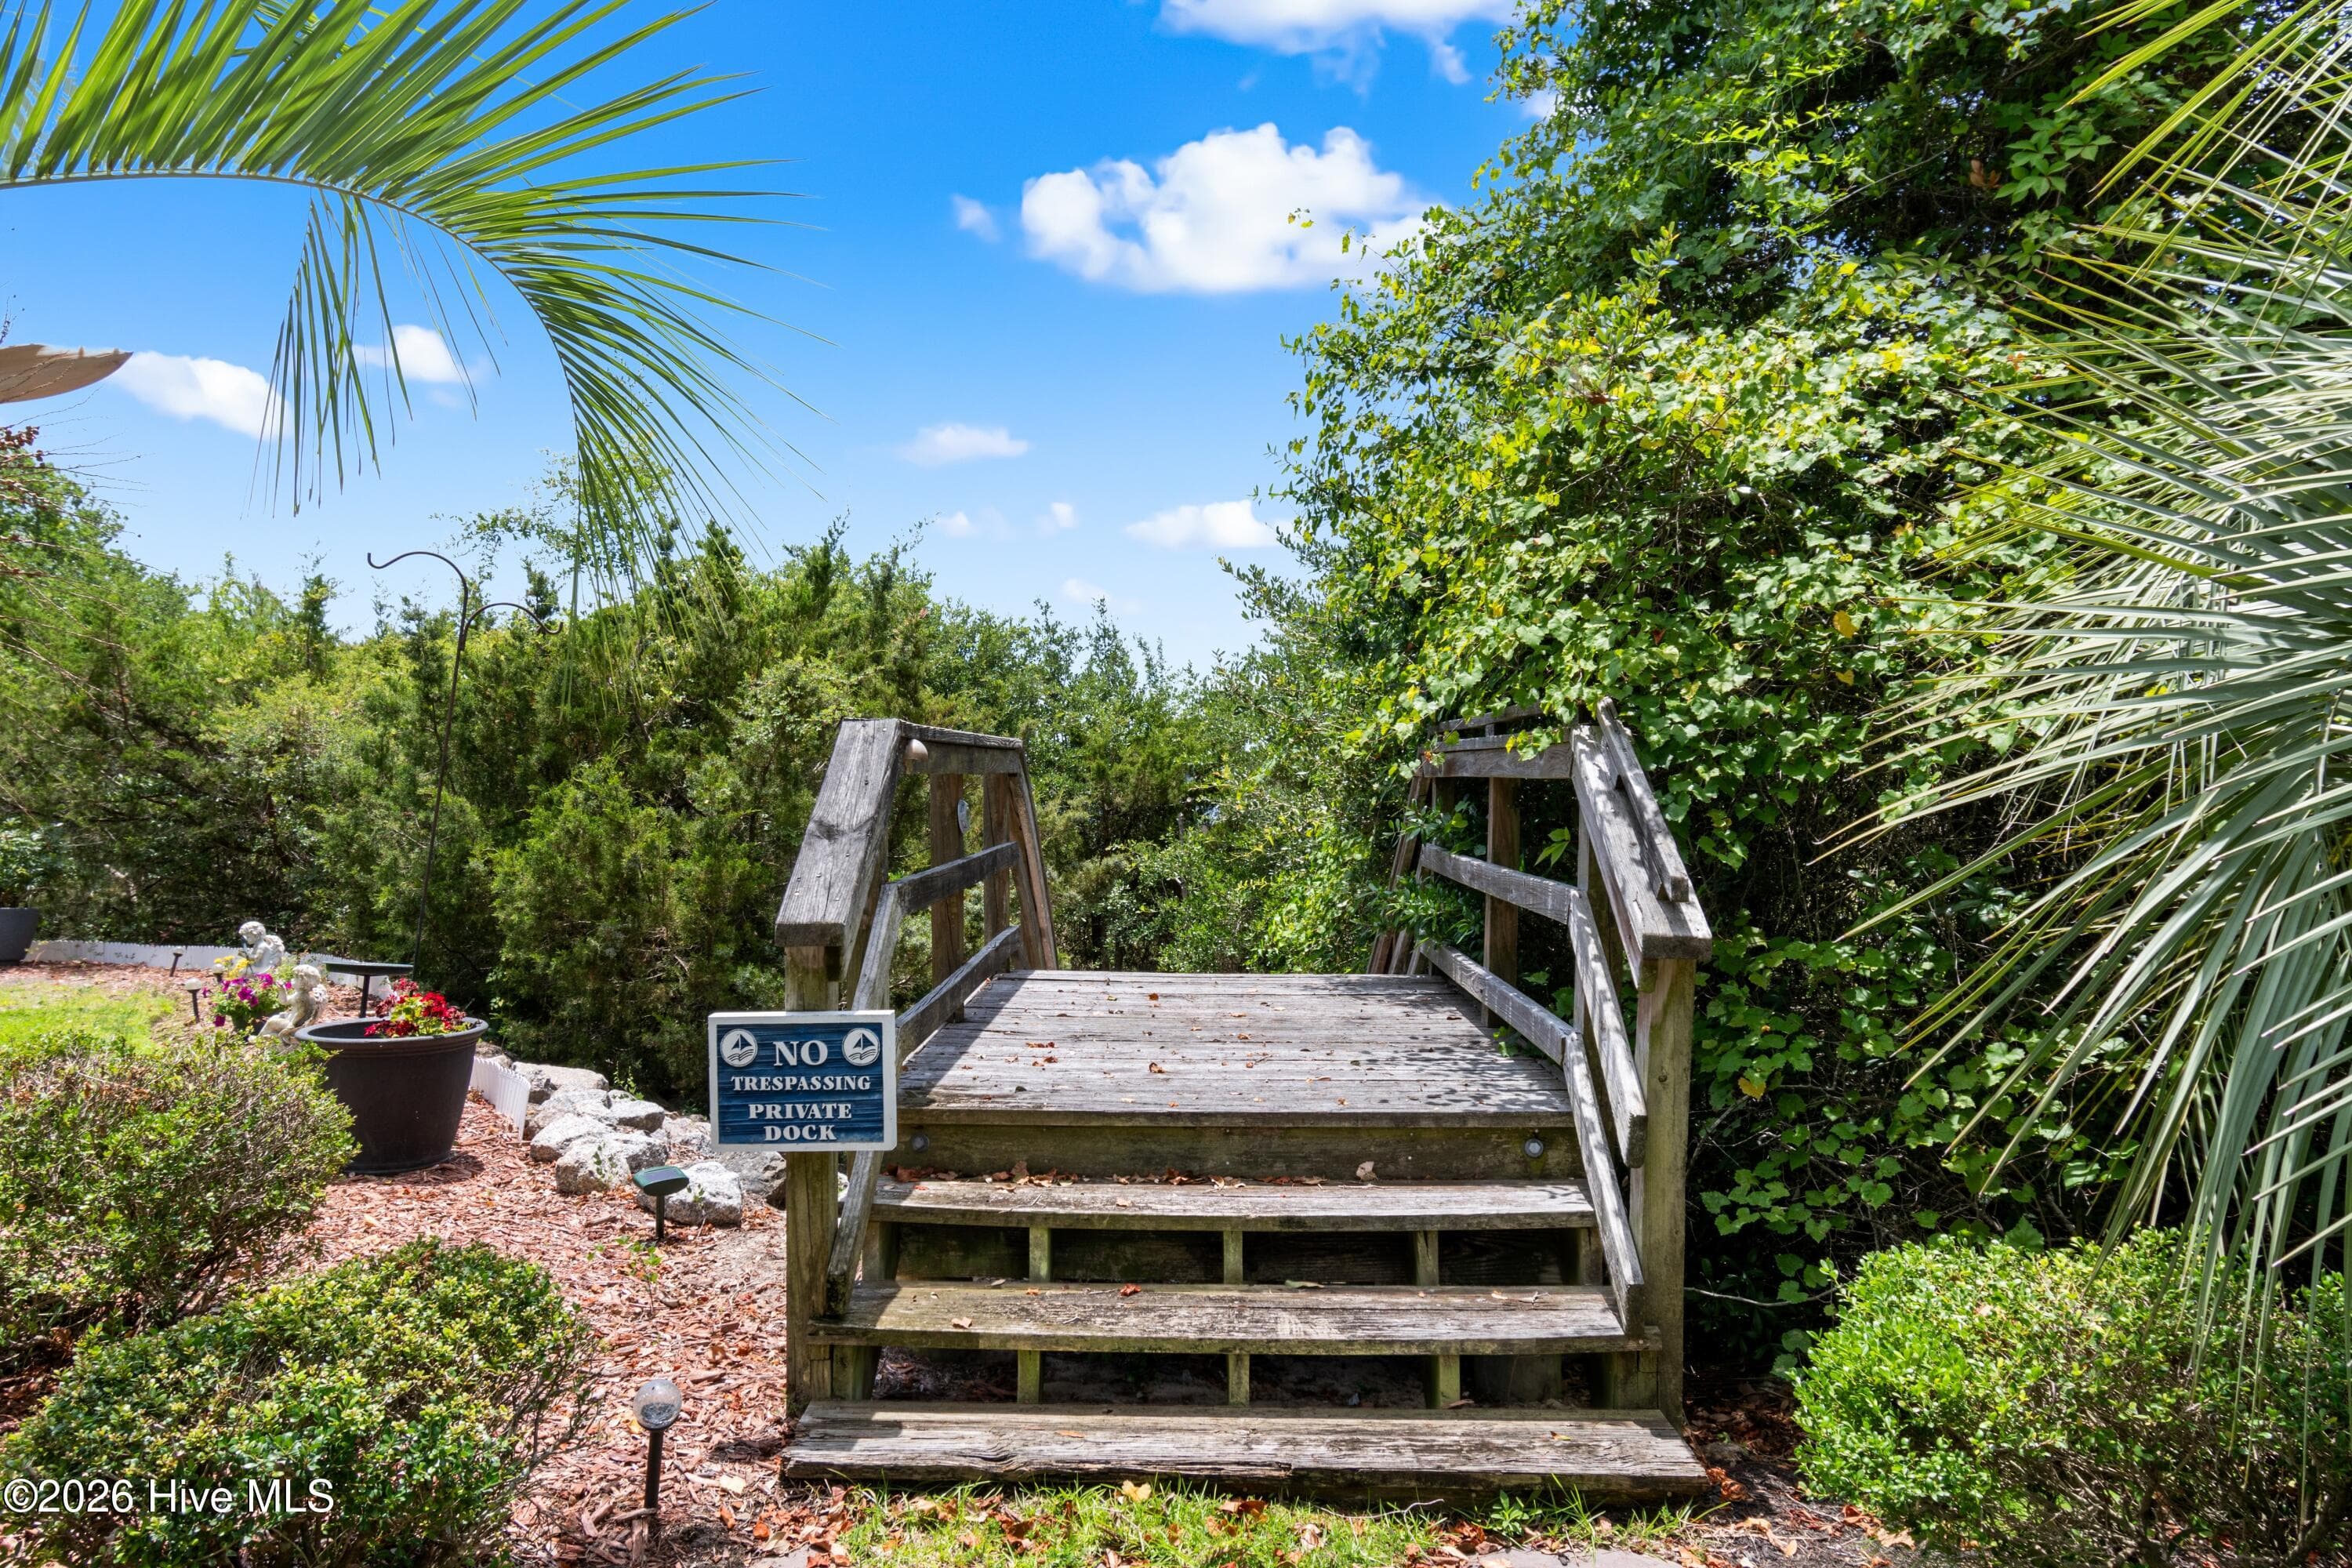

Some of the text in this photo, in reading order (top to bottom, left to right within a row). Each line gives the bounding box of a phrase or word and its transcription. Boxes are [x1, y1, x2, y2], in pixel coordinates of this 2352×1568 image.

[772, 1040, 829, 1067] NO
[731, 1076, 871, 1091] TRESPASSING
[748, 1103, 852, 1120] PRIVATE
[763, 1124, 837, 1142] DOCK
